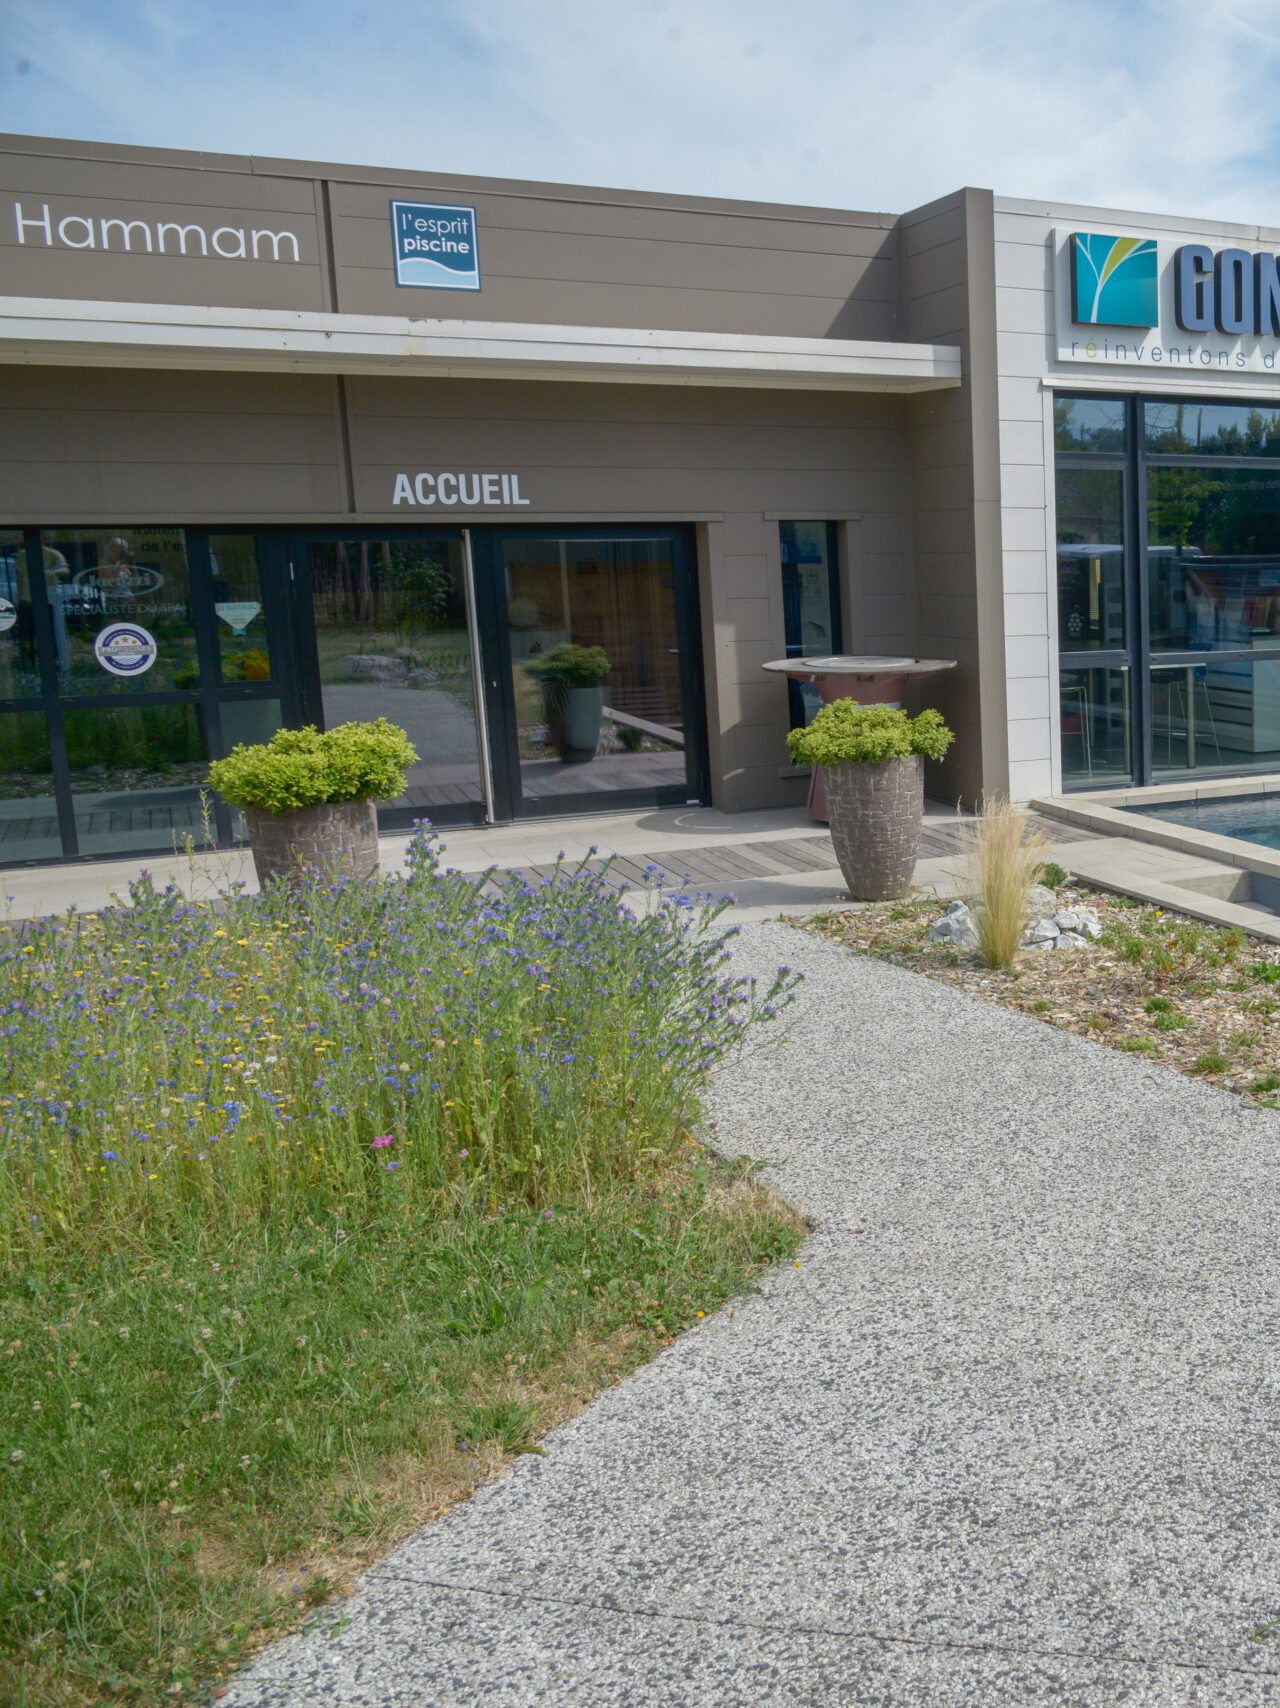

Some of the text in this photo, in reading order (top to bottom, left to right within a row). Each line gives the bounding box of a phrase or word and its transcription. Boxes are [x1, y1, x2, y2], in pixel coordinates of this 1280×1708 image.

[13, 202, 301, 262] Hammam
[402, 213, 469, 236] l'esprit
[403, 235, 471, 254] piscine
[1071, 337, 1247, 369] réinventons
[393, 473, 530, 505] ACCUEIL
